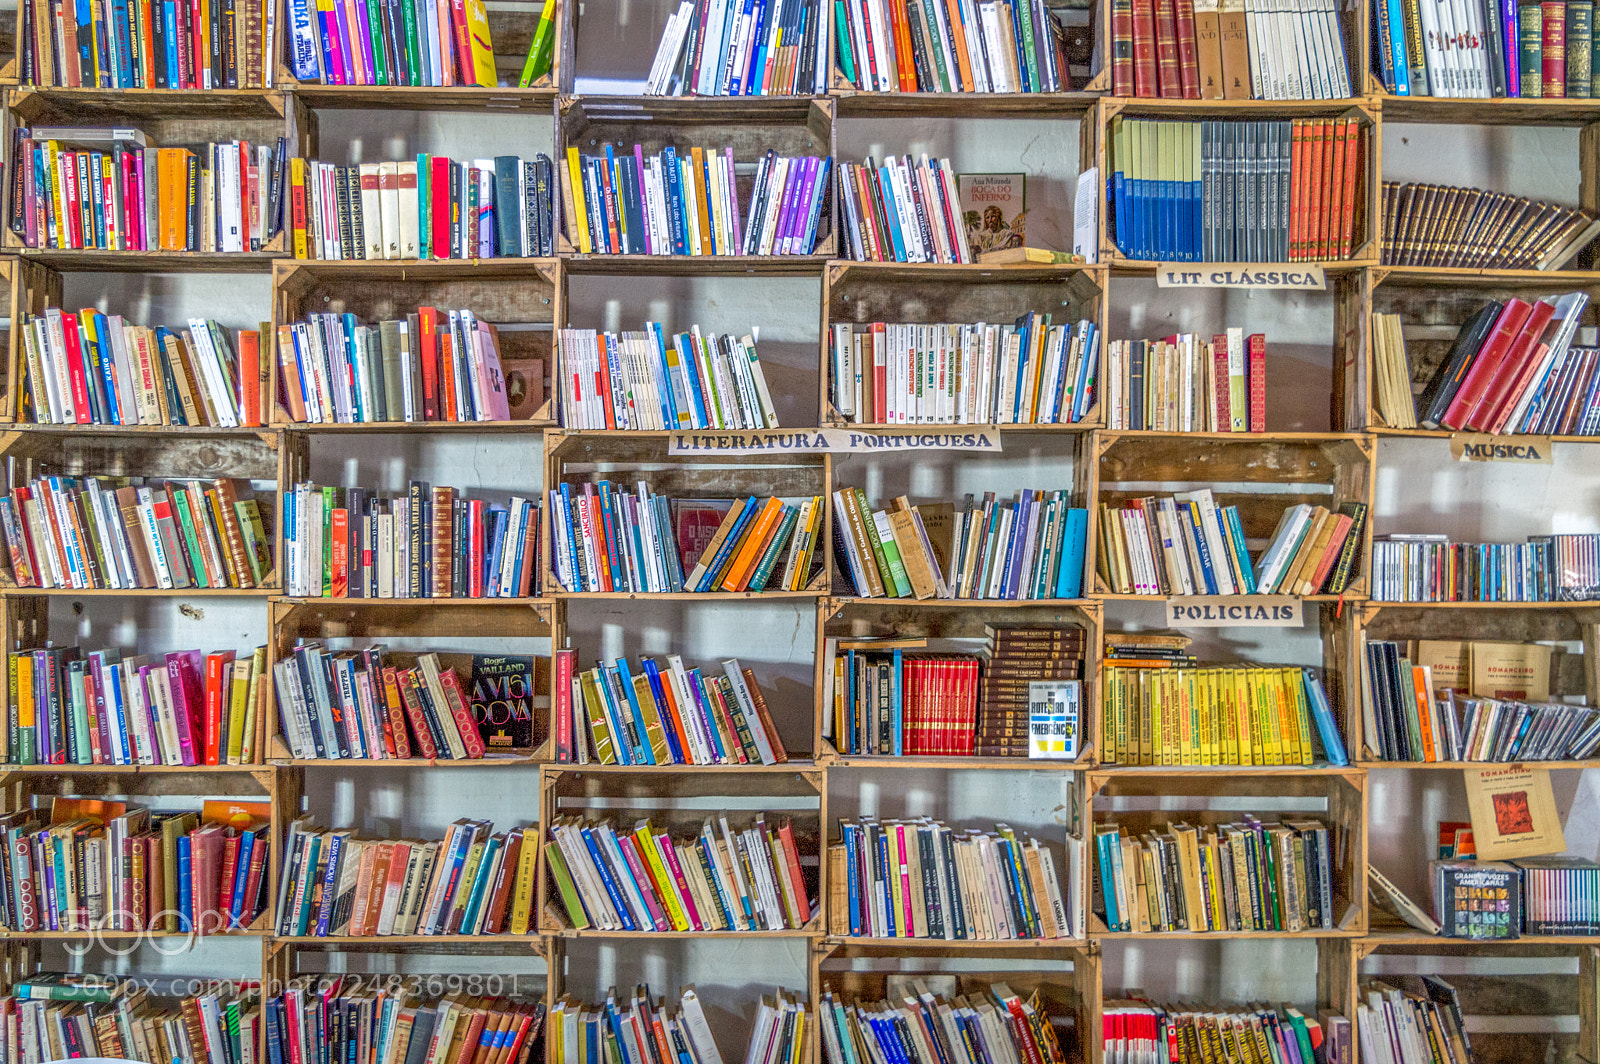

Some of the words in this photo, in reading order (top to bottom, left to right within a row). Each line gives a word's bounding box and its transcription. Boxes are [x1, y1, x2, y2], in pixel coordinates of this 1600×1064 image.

[1383, 26, 1393, 70] PORTUGAL
[65, 156, 74, 177] PALMER
[79, 156, 87, 178] PALMER
[92, 158, 100, 179] PALMER
[67, 178, 76, 201] MICHAEL
[80, 179, 89, 201] MICHAEL
[94, 181, 102, 204] MICHAEL
[1210, 268, 1319, 286] CLÁSSICA
[103, 357, 112, 381] KAIKO
[676, 434, 830, 450] LITERATURA
[850, 433, 992, 449] PORTUGUESA
[1464, 439, 1541, 460] MÚSICA
[411, 498, 420, 525] MULHER
[580, 499, 591, 538] SANCIRILO
[411, 566, 419, 592] HAROLD
[1173, 606, 1294, 621] POLICIAIS
[340, 669, 351, 699] TREPPER
[330, 838, 340, 856] WEST
[328, 857, 337, 881] MORRIS
